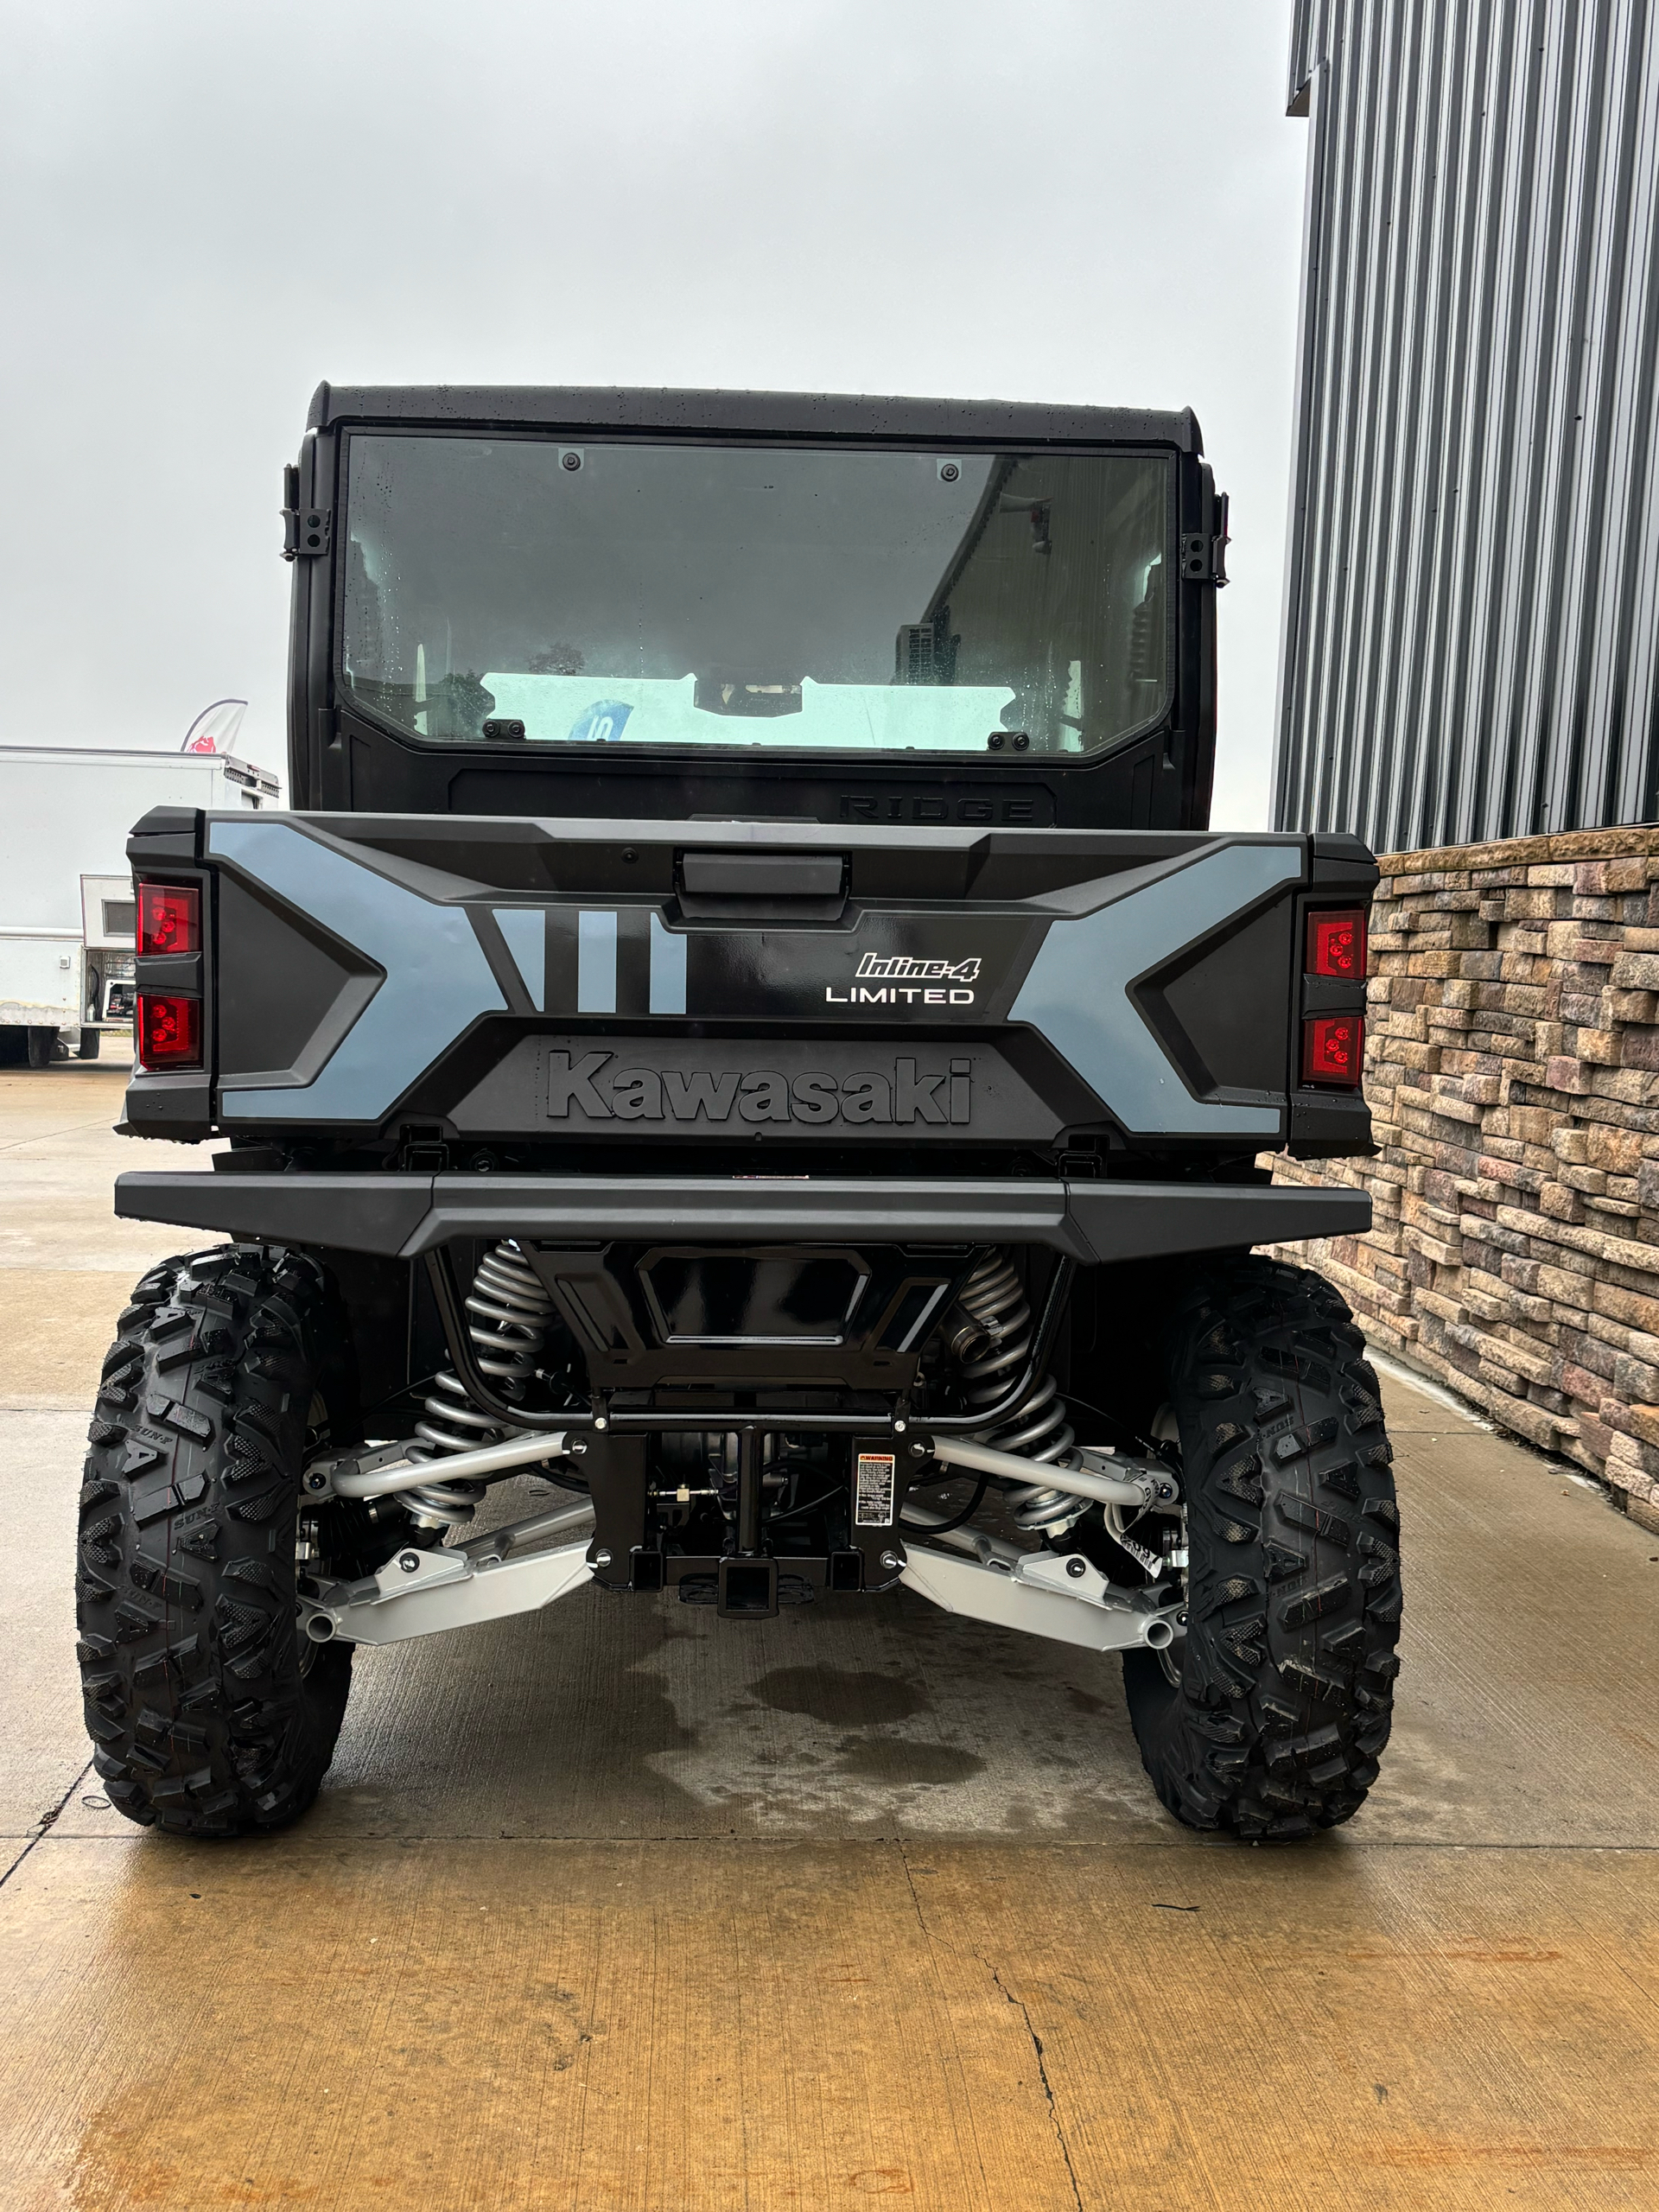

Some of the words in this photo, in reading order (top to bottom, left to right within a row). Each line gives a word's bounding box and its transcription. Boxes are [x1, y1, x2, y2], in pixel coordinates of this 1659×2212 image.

[839, 795, 1033, 819] RIDGE
[855, 953, 982, 982] Inline-4
[825, 987, 975, 1004] LIMITED
[546, 1049, 971, 1124] Kawasaki
